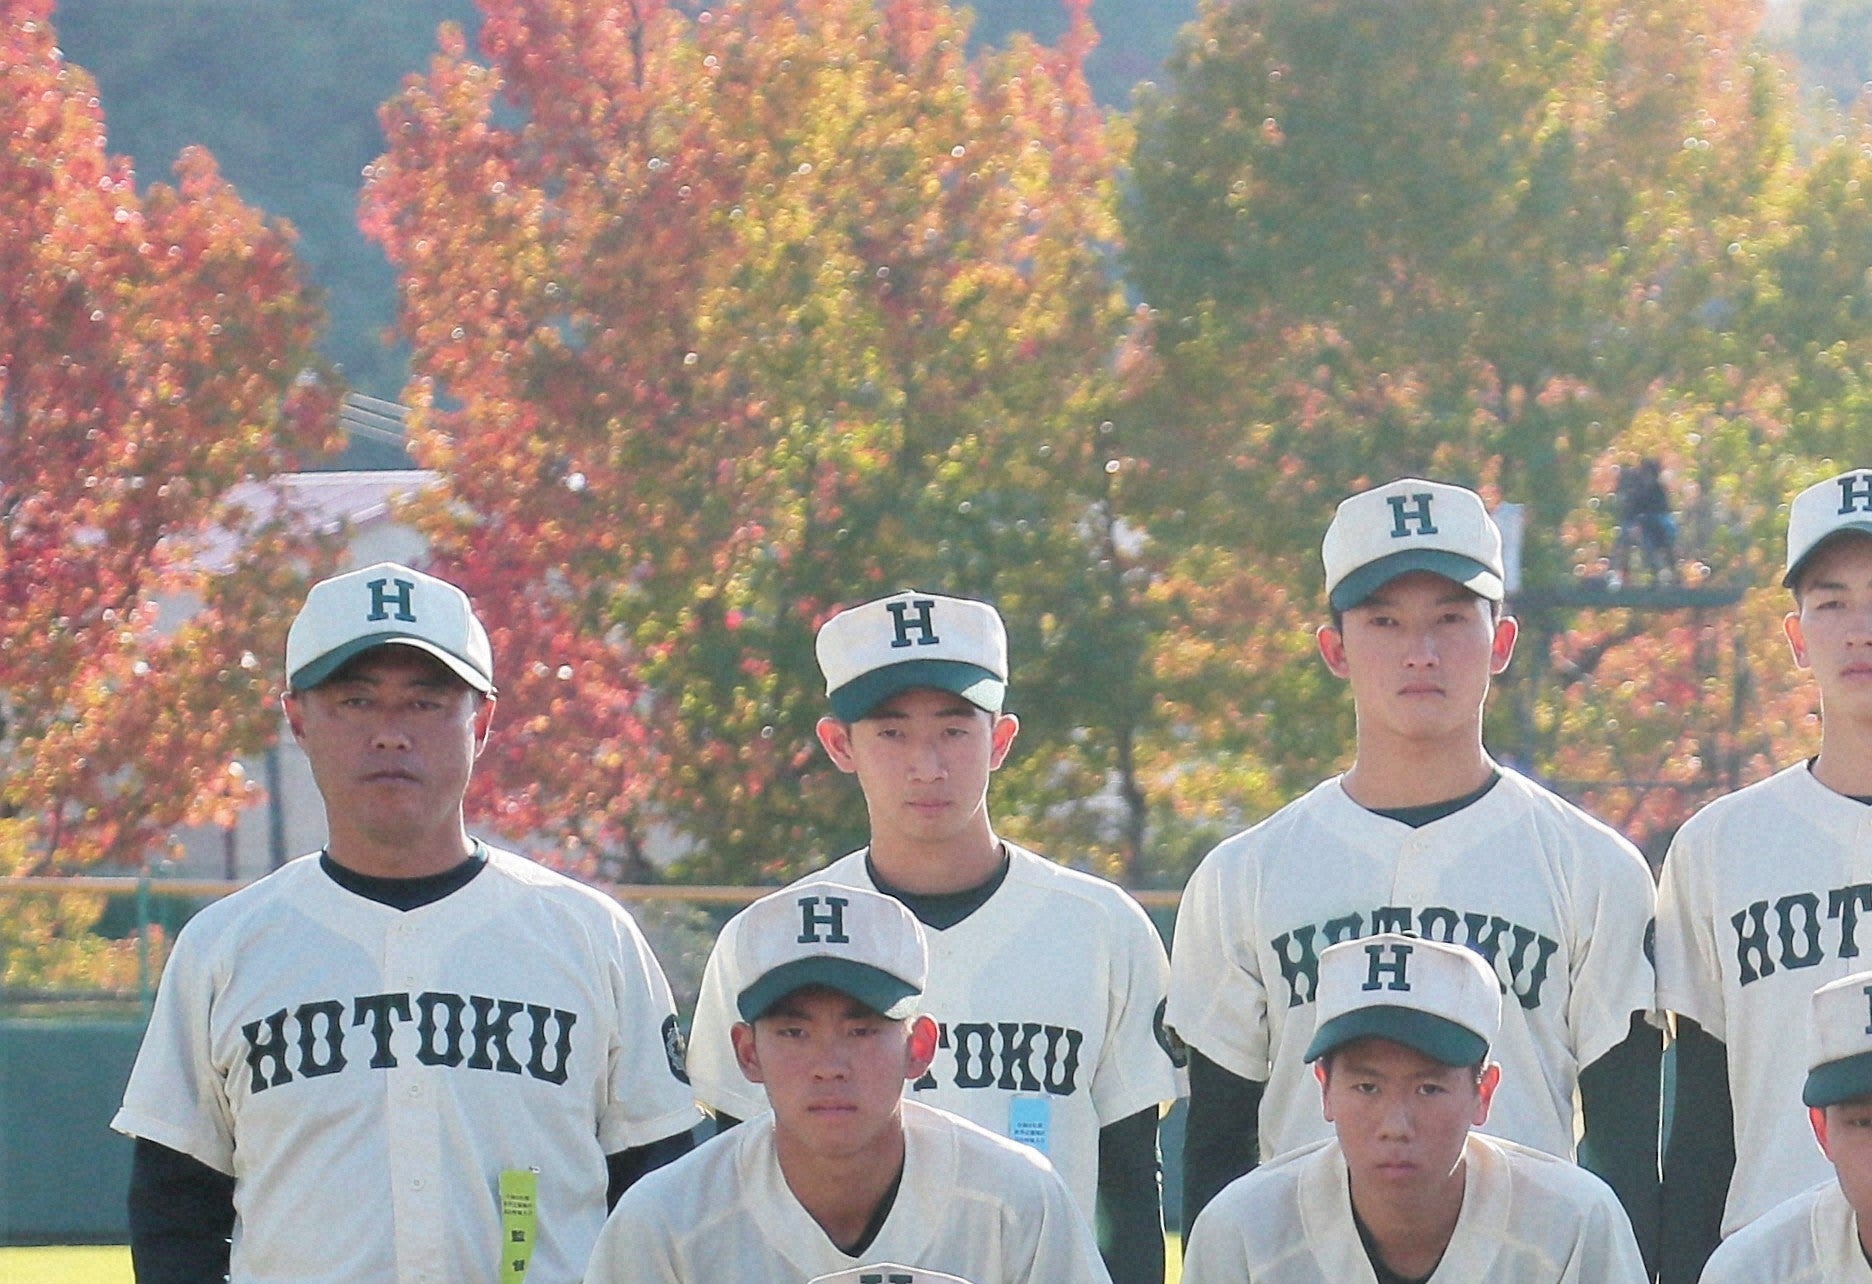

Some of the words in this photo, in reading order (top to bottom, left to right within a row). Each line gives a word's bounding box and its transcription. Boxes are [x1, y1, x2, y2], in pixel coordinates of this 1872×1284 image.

[1387, 494, 1439, 537] H
[367, 579, 415, 622] H
[890, 600, 940, 647] H
[797, 896, 849, 944] H
[1362, 944, 1413, 991] H
[241, 991, 578, 1094] HOTOKU
